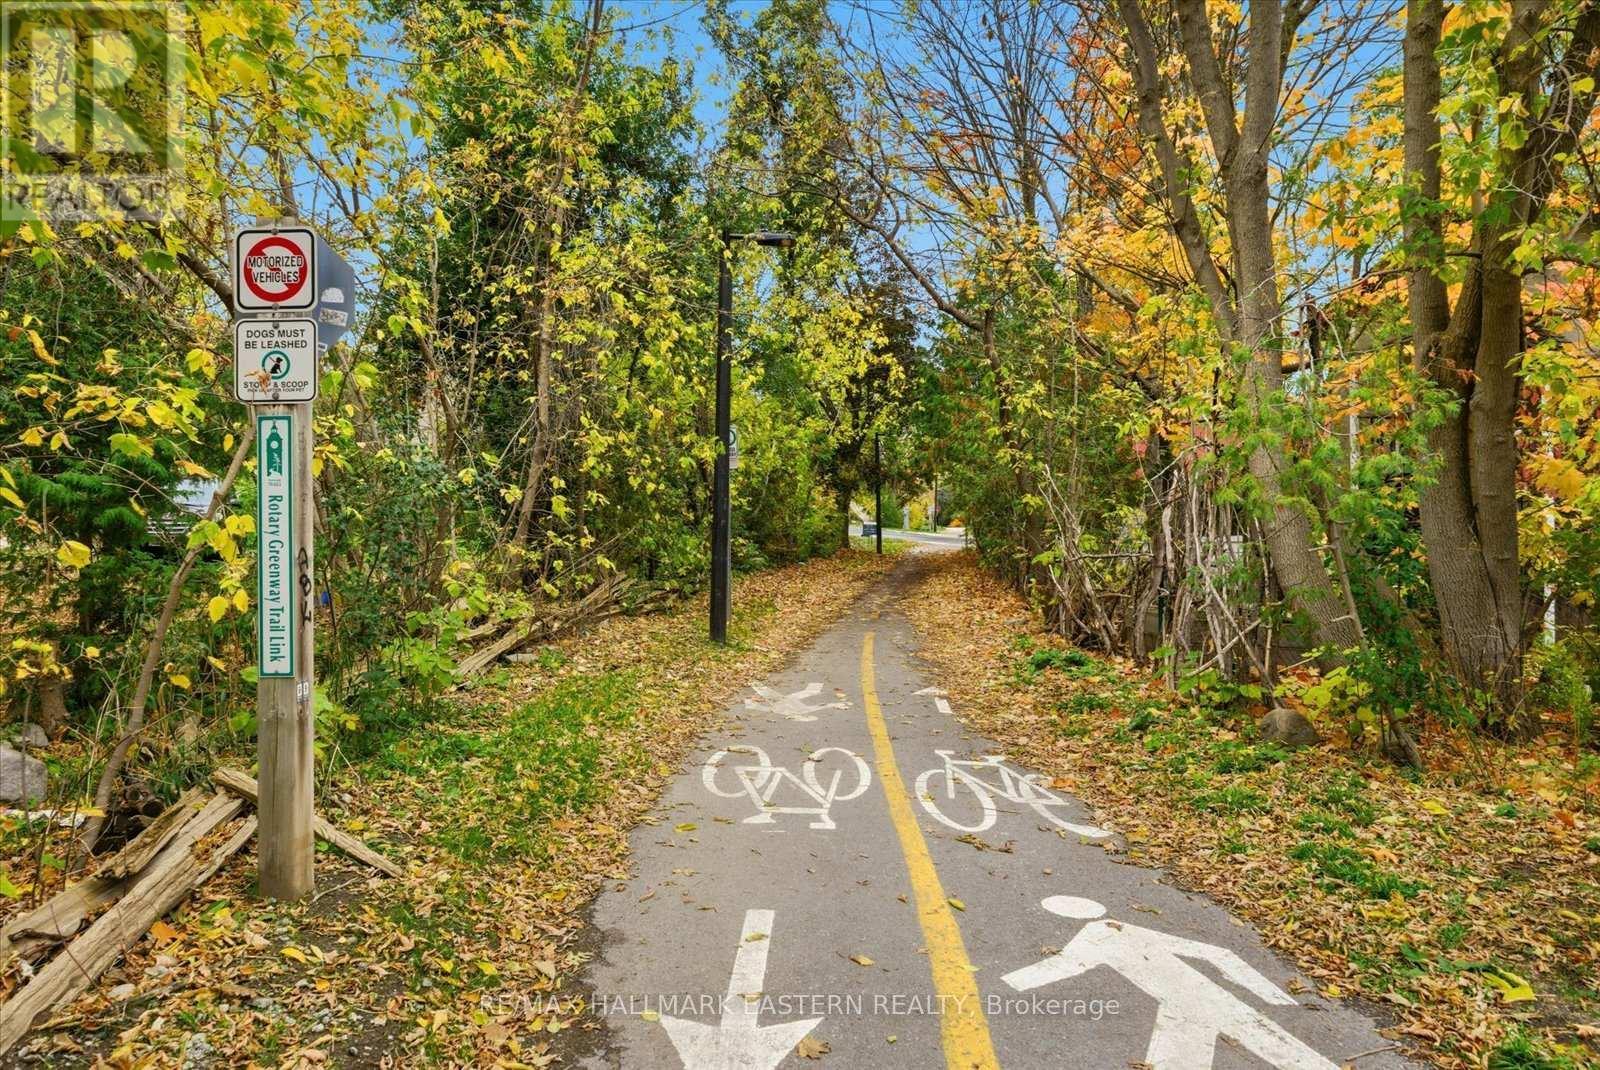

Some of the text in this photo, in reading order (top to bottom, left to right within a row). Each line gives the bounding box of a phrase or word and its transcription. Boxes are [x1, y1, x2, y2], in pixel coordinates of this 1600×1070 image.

[248, 256, 303, 267] MOTORIZED
[253, 271, 299, 283] VEHICLES
[246, 329, 305, 338] DOGS MUST
[244, 340, 308, 349] BE LEASHED
[263, 495, 283, 536] Rotary
[264, 540, 284, 604] Greenway
[269, 606, 286, 632] Trail
[269, 637, 286, 663] Link
